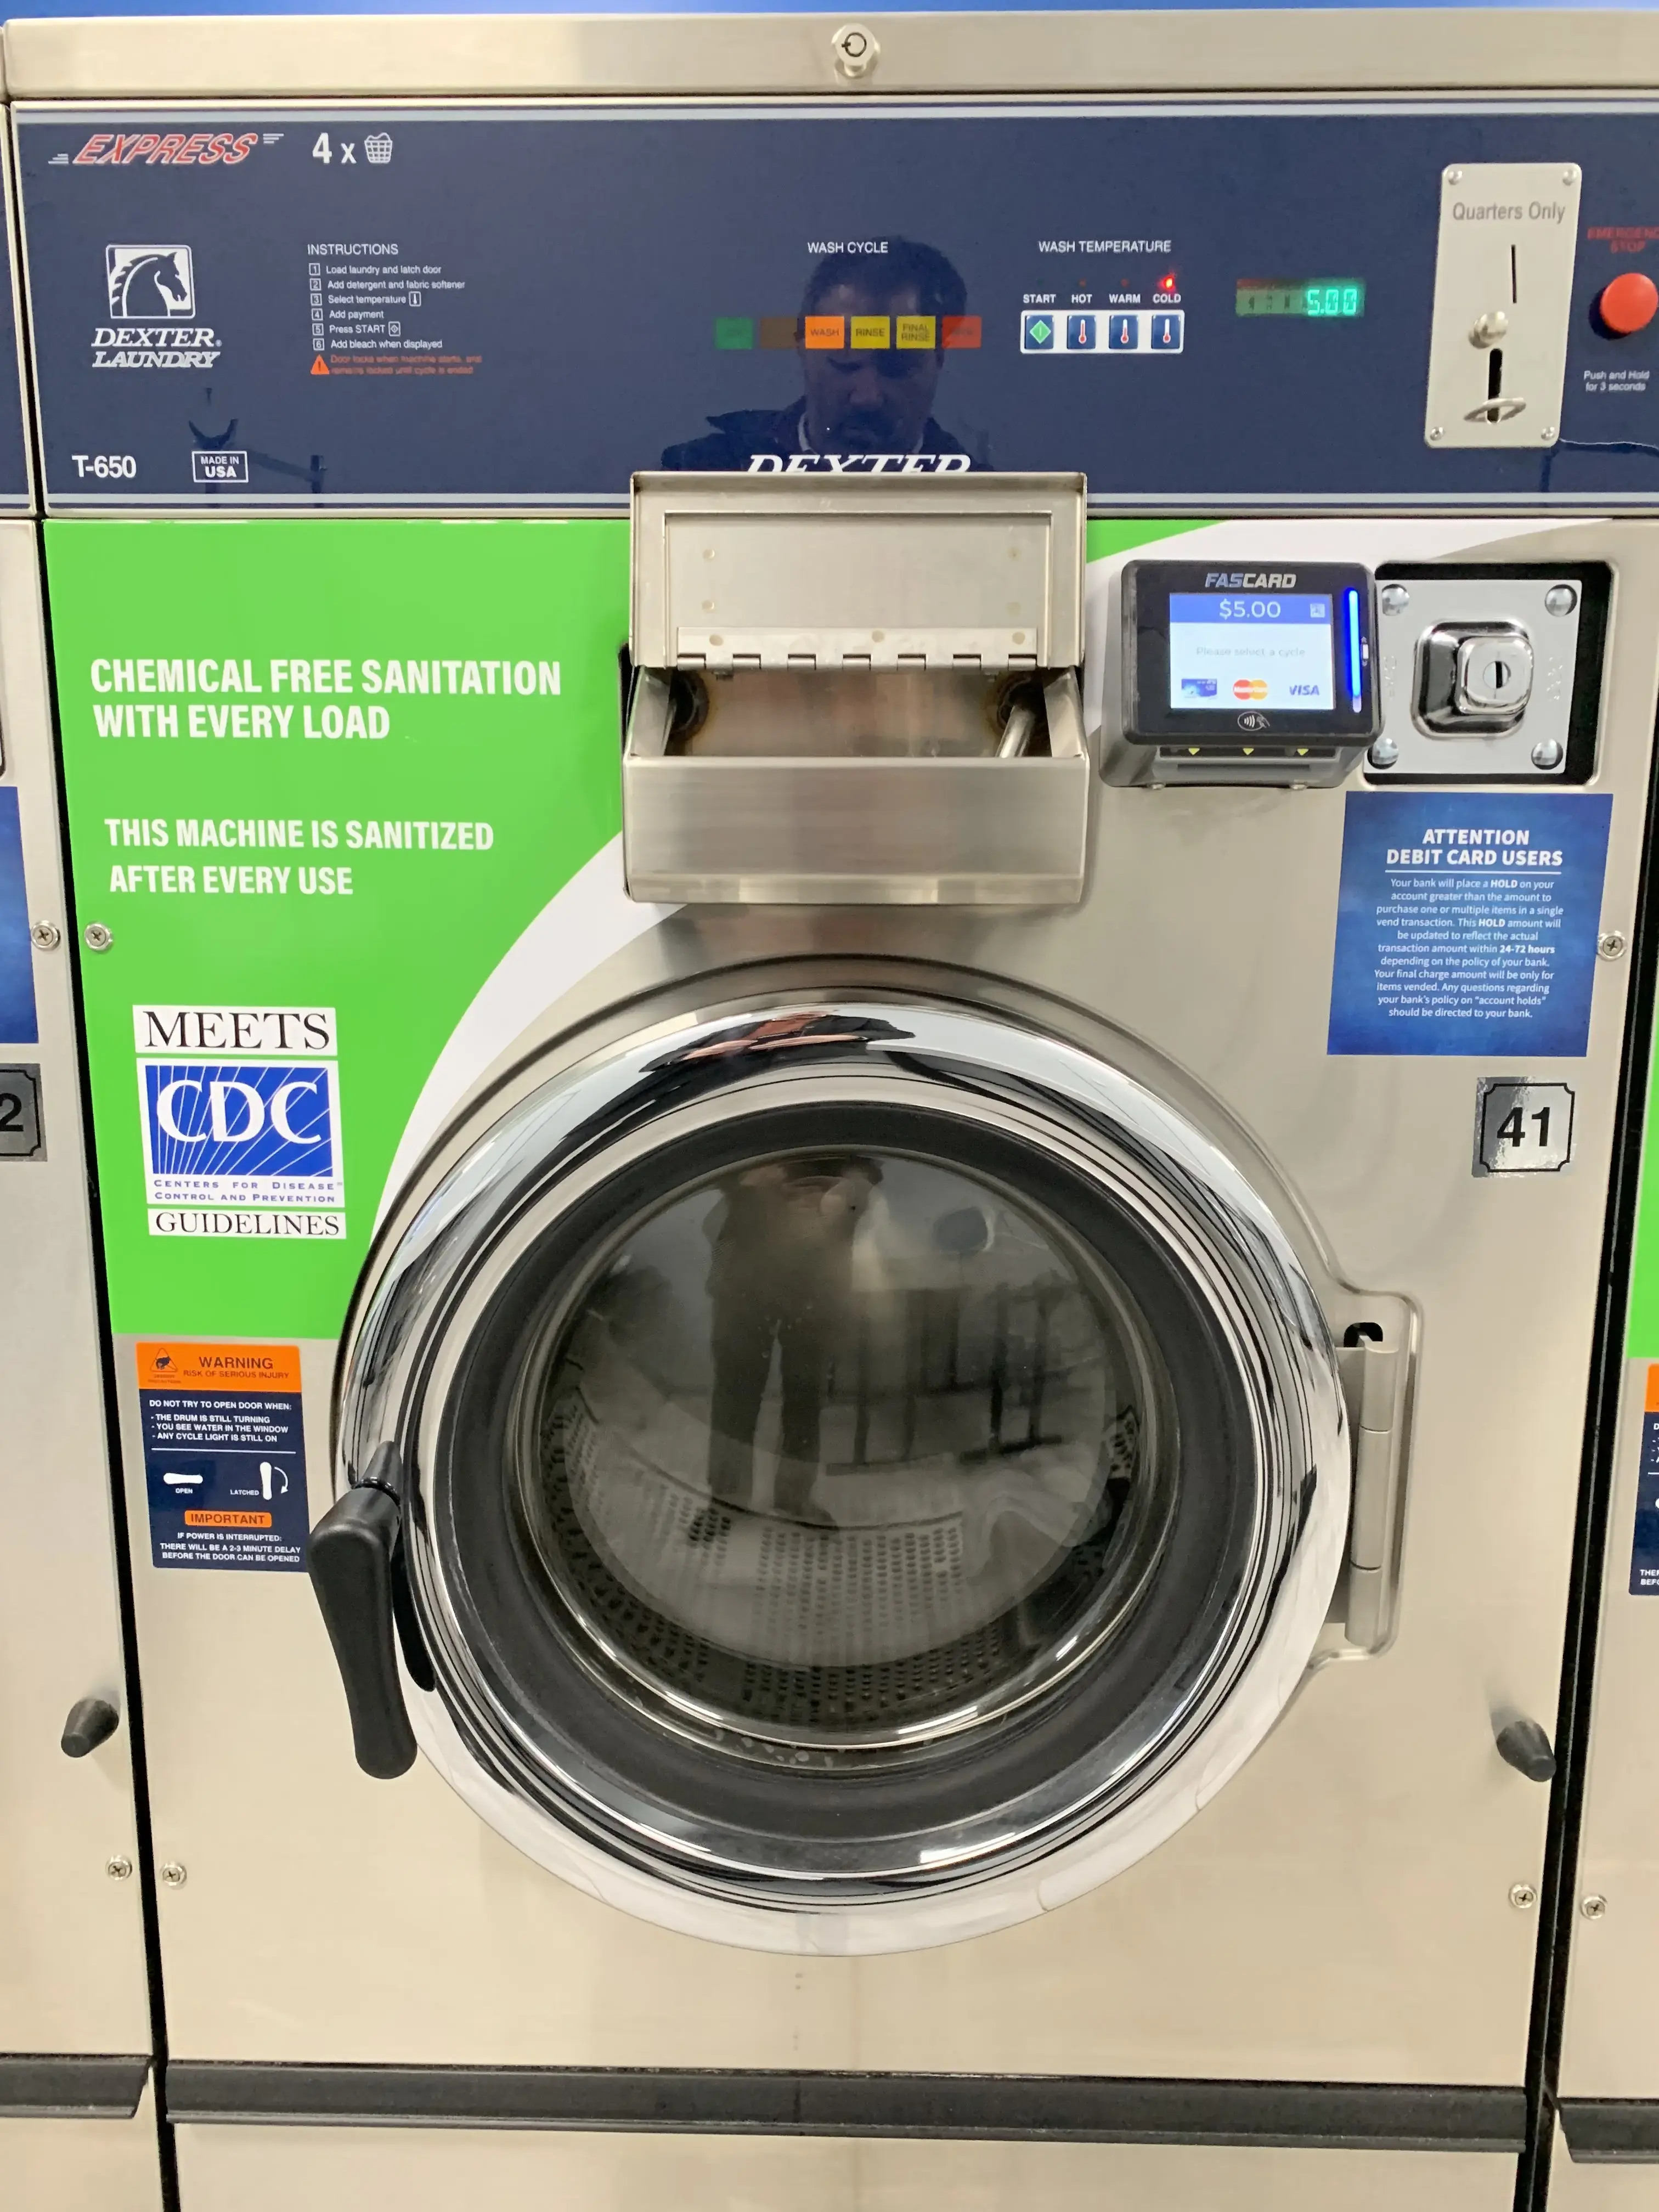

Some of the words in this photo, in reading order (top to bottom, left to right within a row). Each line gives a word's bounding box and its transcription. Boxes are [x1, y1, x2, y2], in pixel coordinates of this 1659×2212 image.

[72, 133, 258, 165] EXPRESS
[313, 133, 332, 163] 4
[341, 142, 356, 163] x
[1453, 202, 1522, 220] Quarters
[1529, 201, 1565, 223] Only
[307, 244, 398, 255] INSTRUCTIONS
[808, 242, 844, 253] WASH
[847, 242, 888, 253] CYCLE
[1039, 241, 1075, 252] WASH
[1080, 240, 1171, 252] TEMPERATURE
[349, 266, 380, 275] laundry
[347, 281, 386, 290] detergent
[356, 296, 406, 305] temperature
[1023, 295, 1056, 303] START
[1071, 295, 1092, 303] HOT
[1109, 295, 1141, 303] WARM
[1153, 295, 1181, 303] COLD
[1307, 289, 1358, 316] 5.00
[348, 311, 383, 320] payment
[856, 328, 884, 337] RINSE
[901, 332, 930, 341] RINSE
[404, 340, 442, 350] displayed
[93, 352, 221, 368] LAUNDRY
[1584, 370, 1606, 380] Push
[1629, 370, 1650, 380] Hold
[1609, 382, 1645, 391] seconds
[201, 456, 227, 465] MADE
[72, 456, 137, 479] T-650
[205, 465, 236, 479] USA
[1205, 573, 1296, 588] FASCARD
[1219, 599, 1281, 620] $5.00
[1279, 647, 1305, 657] cycle
[91, 658, 262, 693] CHEMICAL
[270, 659, 353, 694] FREE
[361, 660, 561, 696] SANITATION
[1290, 685, 1319, 695] VISA
[92, 704, 178, 738] WITH
[189, 705, 293, 738] EVERY
[303, 705, 390, 740] LOAD
[105, 818, 168, 847] THIS
[176, 819, 303, 848] MACHINE
[311, 820, 338, 849] IS
[346, 821, 494, 850] SANITIZED
[1422, 829, 1530, 845] ATTENTION
[1387, 849, 1442, 864] DEBIT
[1447, 850, 1497, 865] CARD
[1502, 851, 1562, 866] USERS
[109, 865, 195, 893] AFTER
[204, 866, 291, 894] EVERY
[298, 867, 353, 895] USE
[1391, 879, 1410, 888] Your
[1413, 879, 1436, 888] bank
[1438, 879, 1454, 888] will
[1457, 879, 1481, 890] place
[1491, 880, 1517, 888] HOLD
[1534, 882, 1554, 890] your
[1391, 892, 1427, 900] account
[1430, 893, 1463, 902] greater
[1465, 893, 1485, 901] than
[1376, 905, 1418, 916] purchase
[1452, 906, 1489, 916] multiple
[1537, 906, 1564, 917] single
[1377, 917, 1398, 926] vend
[1401, 918, 1455, 927] transaction.
[1459, 918, 1476, 927] This
[1479, 919, 1505, 927] HOLD
[1545, 919, 1561, 928] will
[1411, 931, 1449, 941] updated
[1463, 931, 1491, 940] reflect
[1510, 932, 1538, 940] actual
[1378, 944, 1429, 952] transaction
[1470, 945, 1497, 953] within
[1500, 945, 1526, 953] 24-72
[1528, 945, 1555, 953] hours
[1381, 957, 1429, 968] depending
[1462, 957, 1489, 968] policy
[1502, 960, 1523, 969] your
[1525, 958, 1549, 966] bank.
[1397, 969, 1417, 978] final
[1419, 970, 1449, 981] charge
[1520, 970, 1539, 981] only
[1377, 983, 1401, 991] items
[1404, 983, 1440, 991] vended.
[1442, 984, 1458, 992] Any
[1460, 984, 1504, 994] questions
[1507, 984, 1549, 994] regarding
[1432, 996, 1459, 1006] policy
[1475, 996, 1514, 1005] "account
[1516, 996, 1546, 1005] holds"
[1435, 1008, 1471, 1017] directed
[1486, 1011, 1505, 1019] your
[1508, 1009, 1532, 1018] bank.
[143, 1011, 330, 1049] MEETS
[157, 1080, 321, 1144] CDC
[1497, 1107, 1551, 1147] 41
[154, 1180, 219, 1188] CENTERS
[272, 1182, 334, 1190] DISEASE
[155, 1192, 213, 1200] CONTROL
[252, 1193, 334, 1202] PREVENTION
[156, 1212, 339, 1235] GUIDELINES
[199, 1357, 273, 1369] WARNING
[191, 1514, 265, 1524] IMPORTANT
